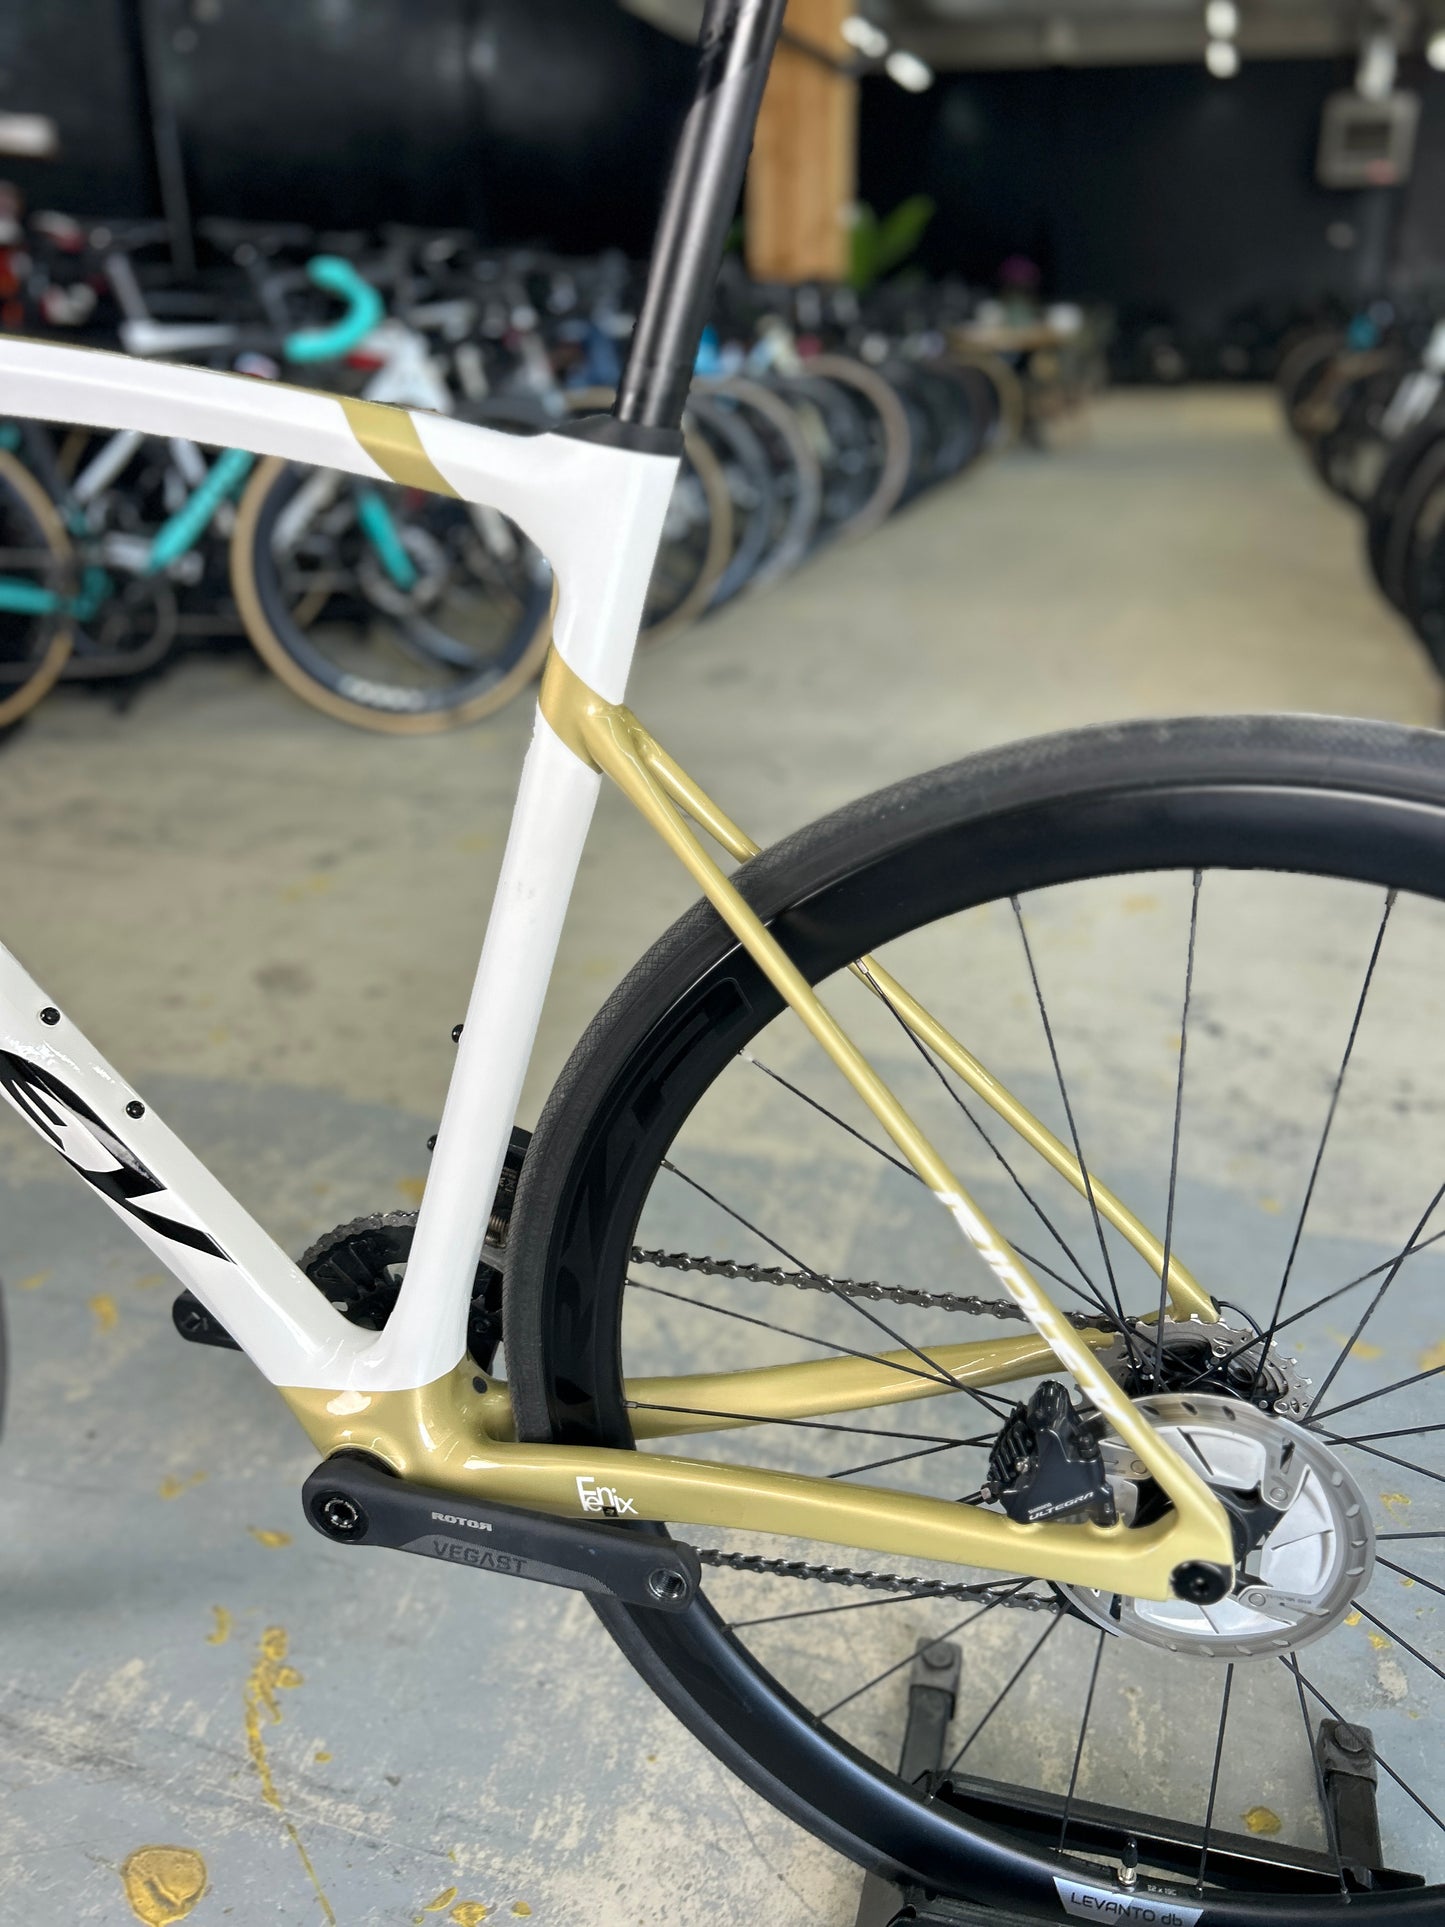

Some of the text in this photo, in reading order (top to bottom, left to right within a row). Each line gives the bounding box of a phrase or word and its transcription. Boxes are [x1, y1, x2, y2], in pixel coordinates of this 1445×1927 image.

[934, 1191, 1136, 1431] RIDLEY
[575, 1476, 639, 1515] Fenix
[1029, 1491, 1094, 1520] ULTEGRA
[431, 1511, 492, 1532] ROTOR
[433, 1540, 528, 1573] VEGAST
[1070, 1891, 1183, 1926] LEVANTO db
